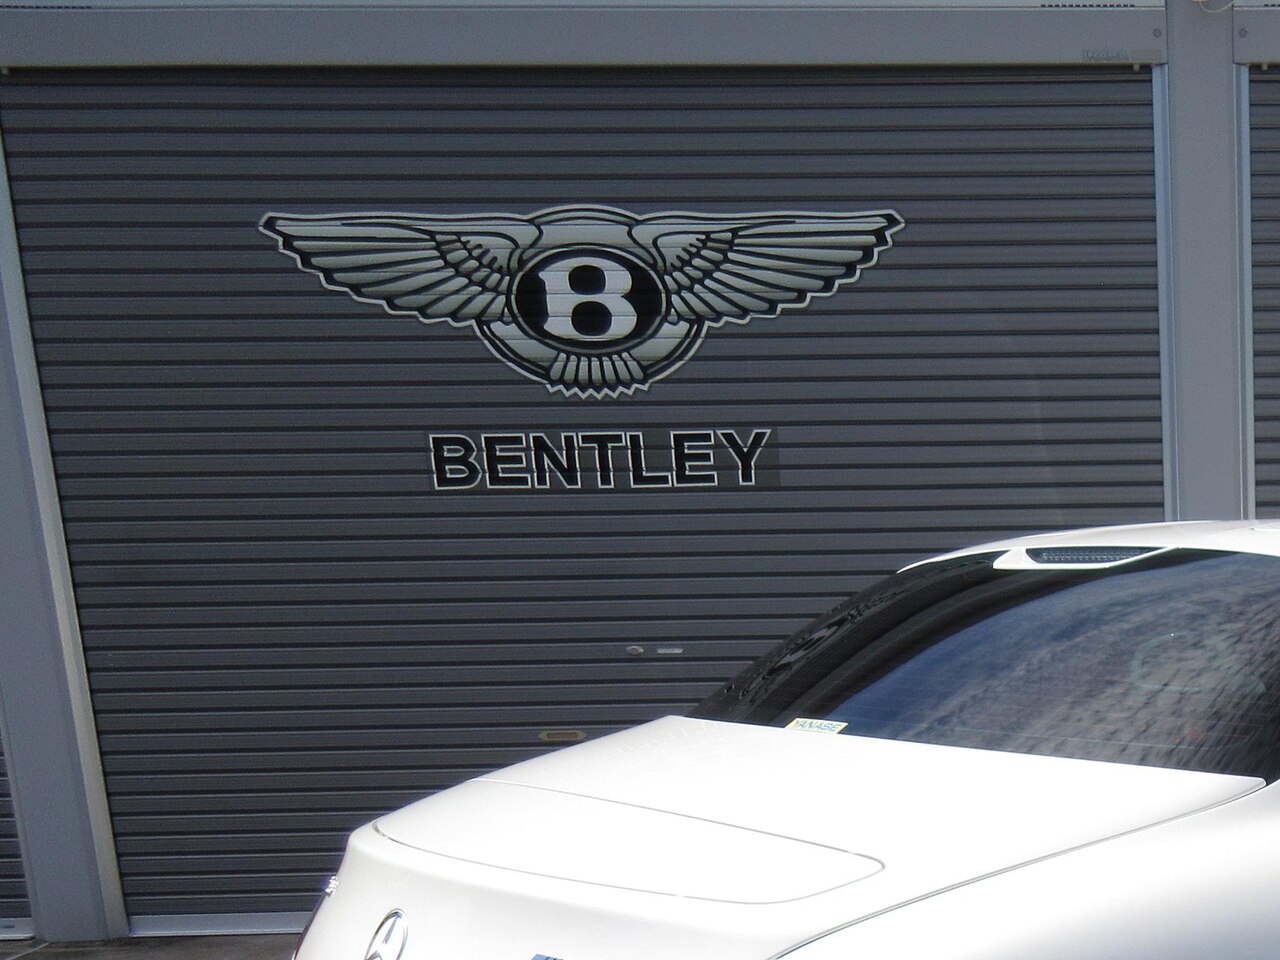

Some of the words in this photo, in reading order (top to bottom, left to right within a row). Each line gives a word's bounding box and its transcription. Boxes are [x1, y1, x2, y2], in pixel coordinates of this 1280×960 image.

[538, 256, 638, 342] B
[428, 428, 772, 490] BENTLEY
[792, 719, 843, 732] YANASE
